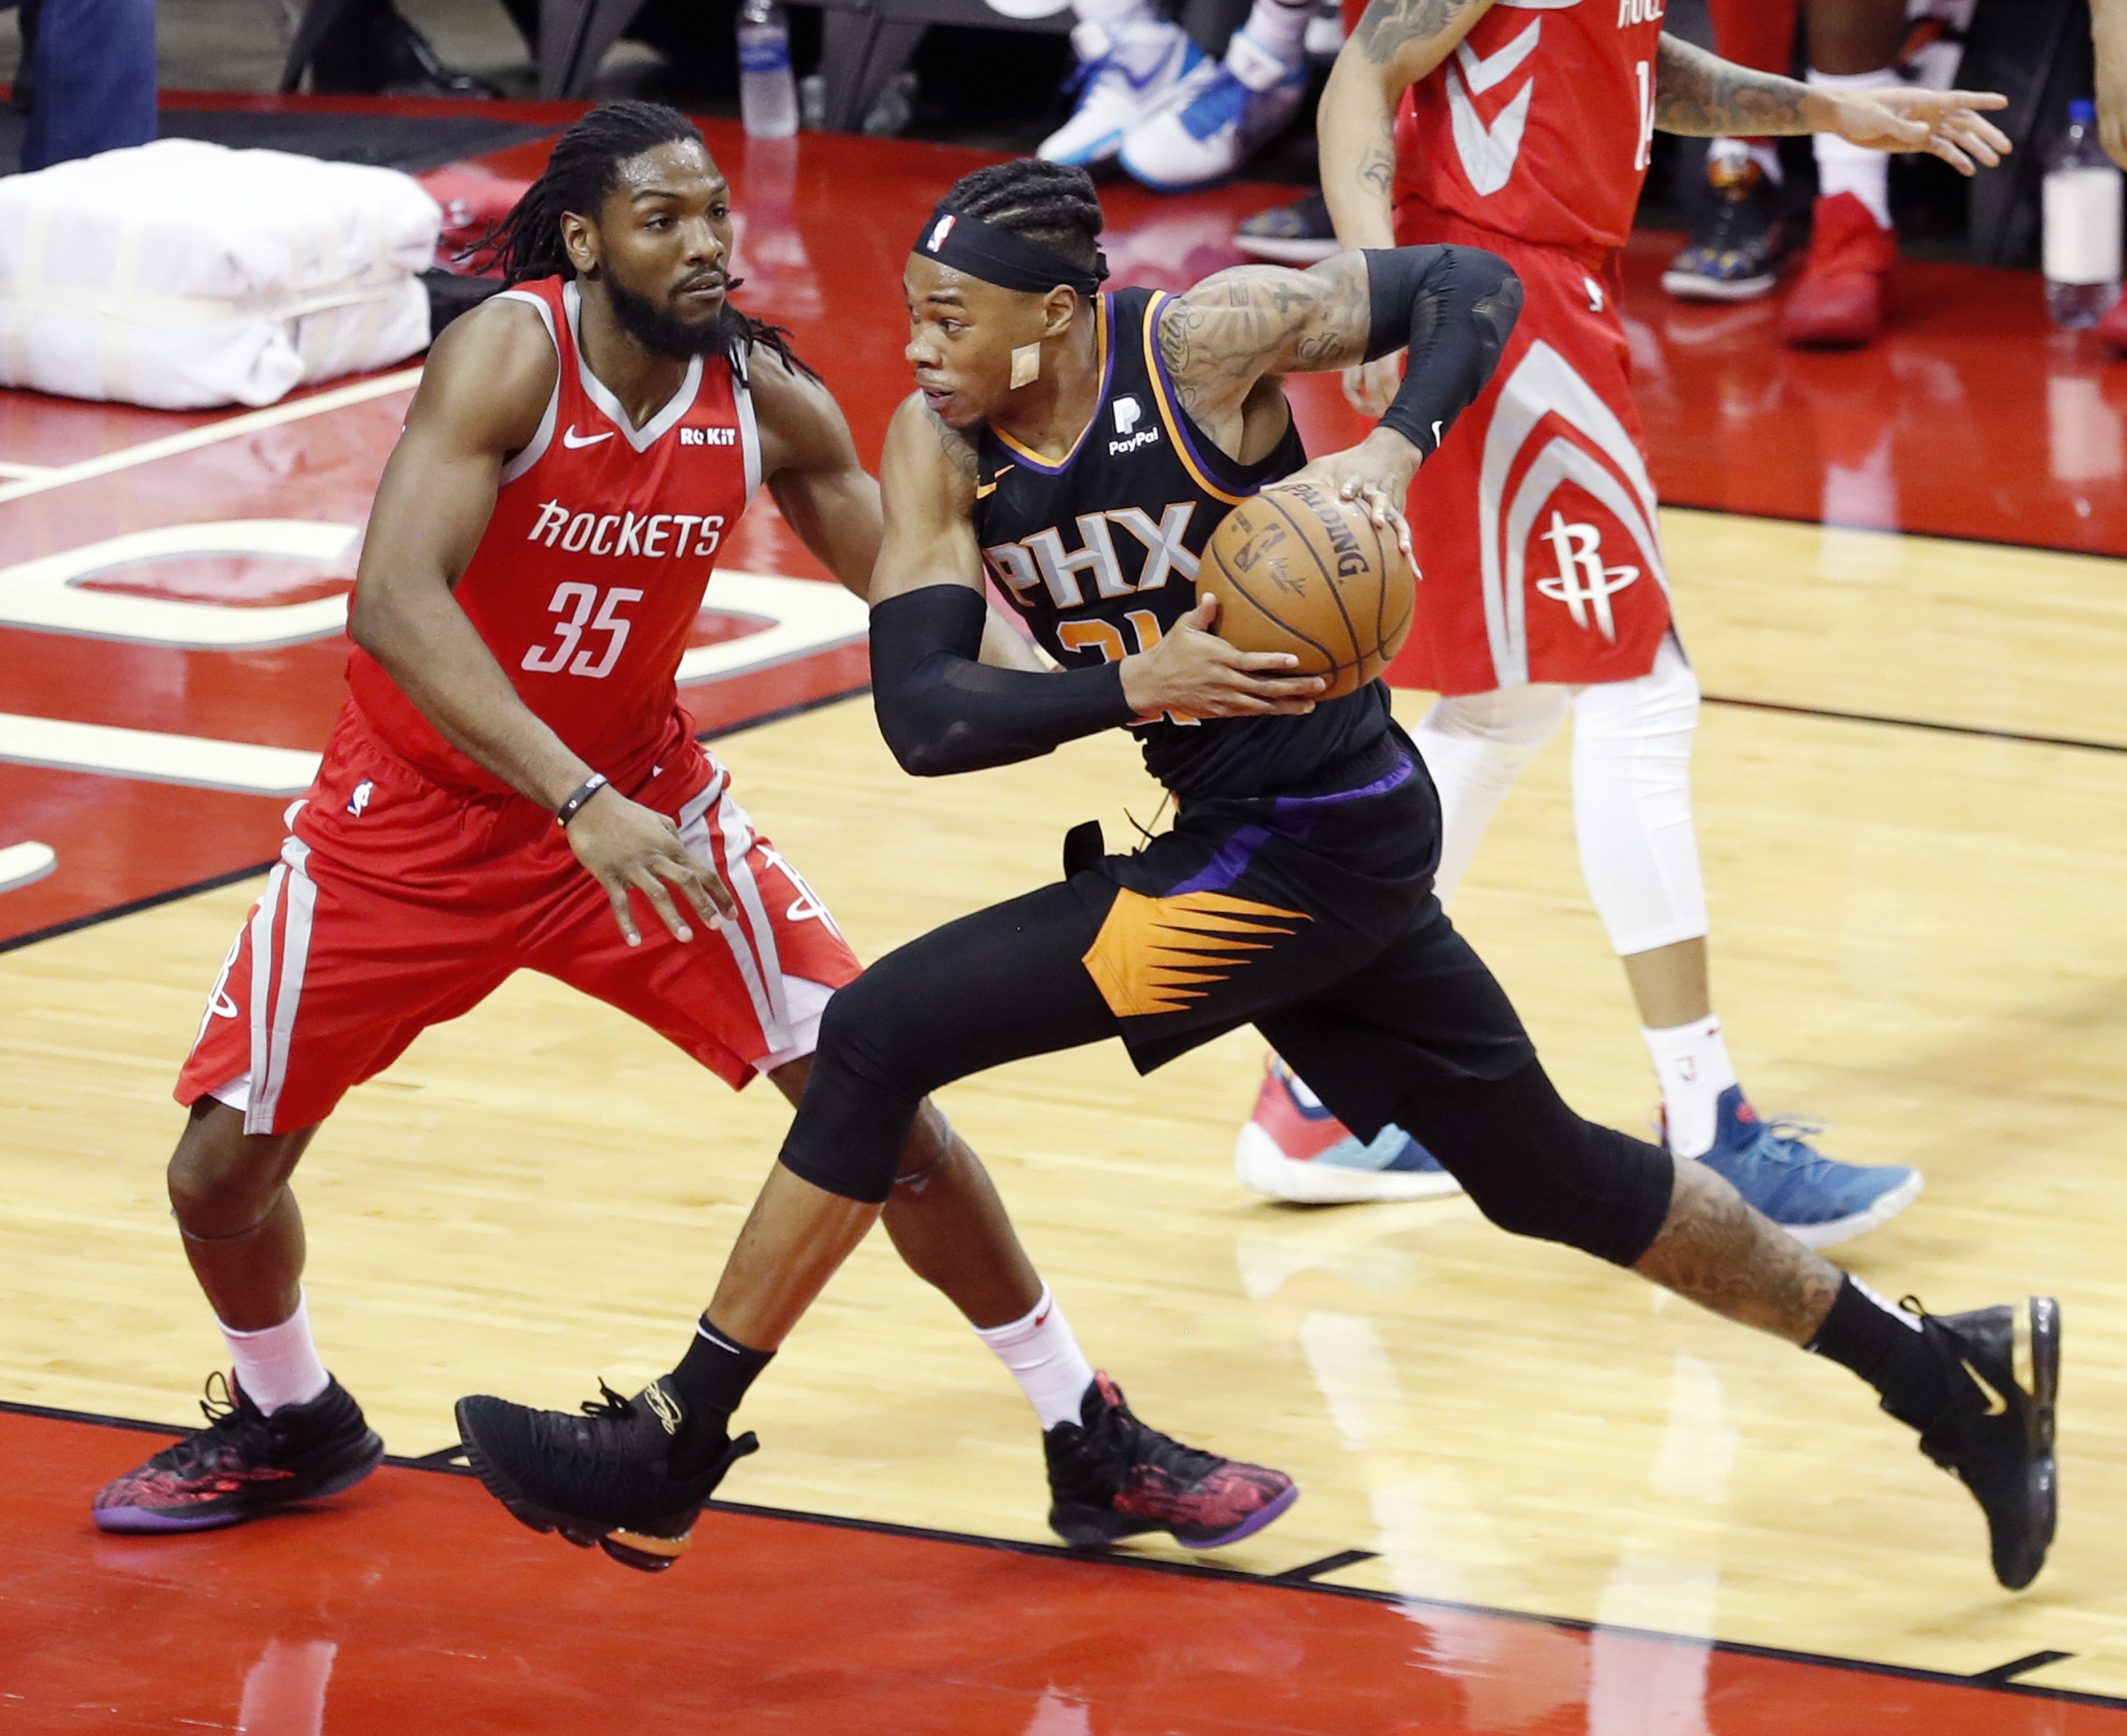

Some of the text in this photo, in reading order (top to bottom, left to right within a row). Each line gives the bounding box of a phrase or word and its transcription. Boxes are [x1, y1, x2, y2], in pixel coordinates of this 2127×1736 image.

[1108, 427, 1159, 456] PayPal
[527, 499, 725, 558] ROCKETS
[981, 500, 1202, 609] PHX
[1274, 483, 1370, 578] PALDING
[520, 581, 644, 679] 35
